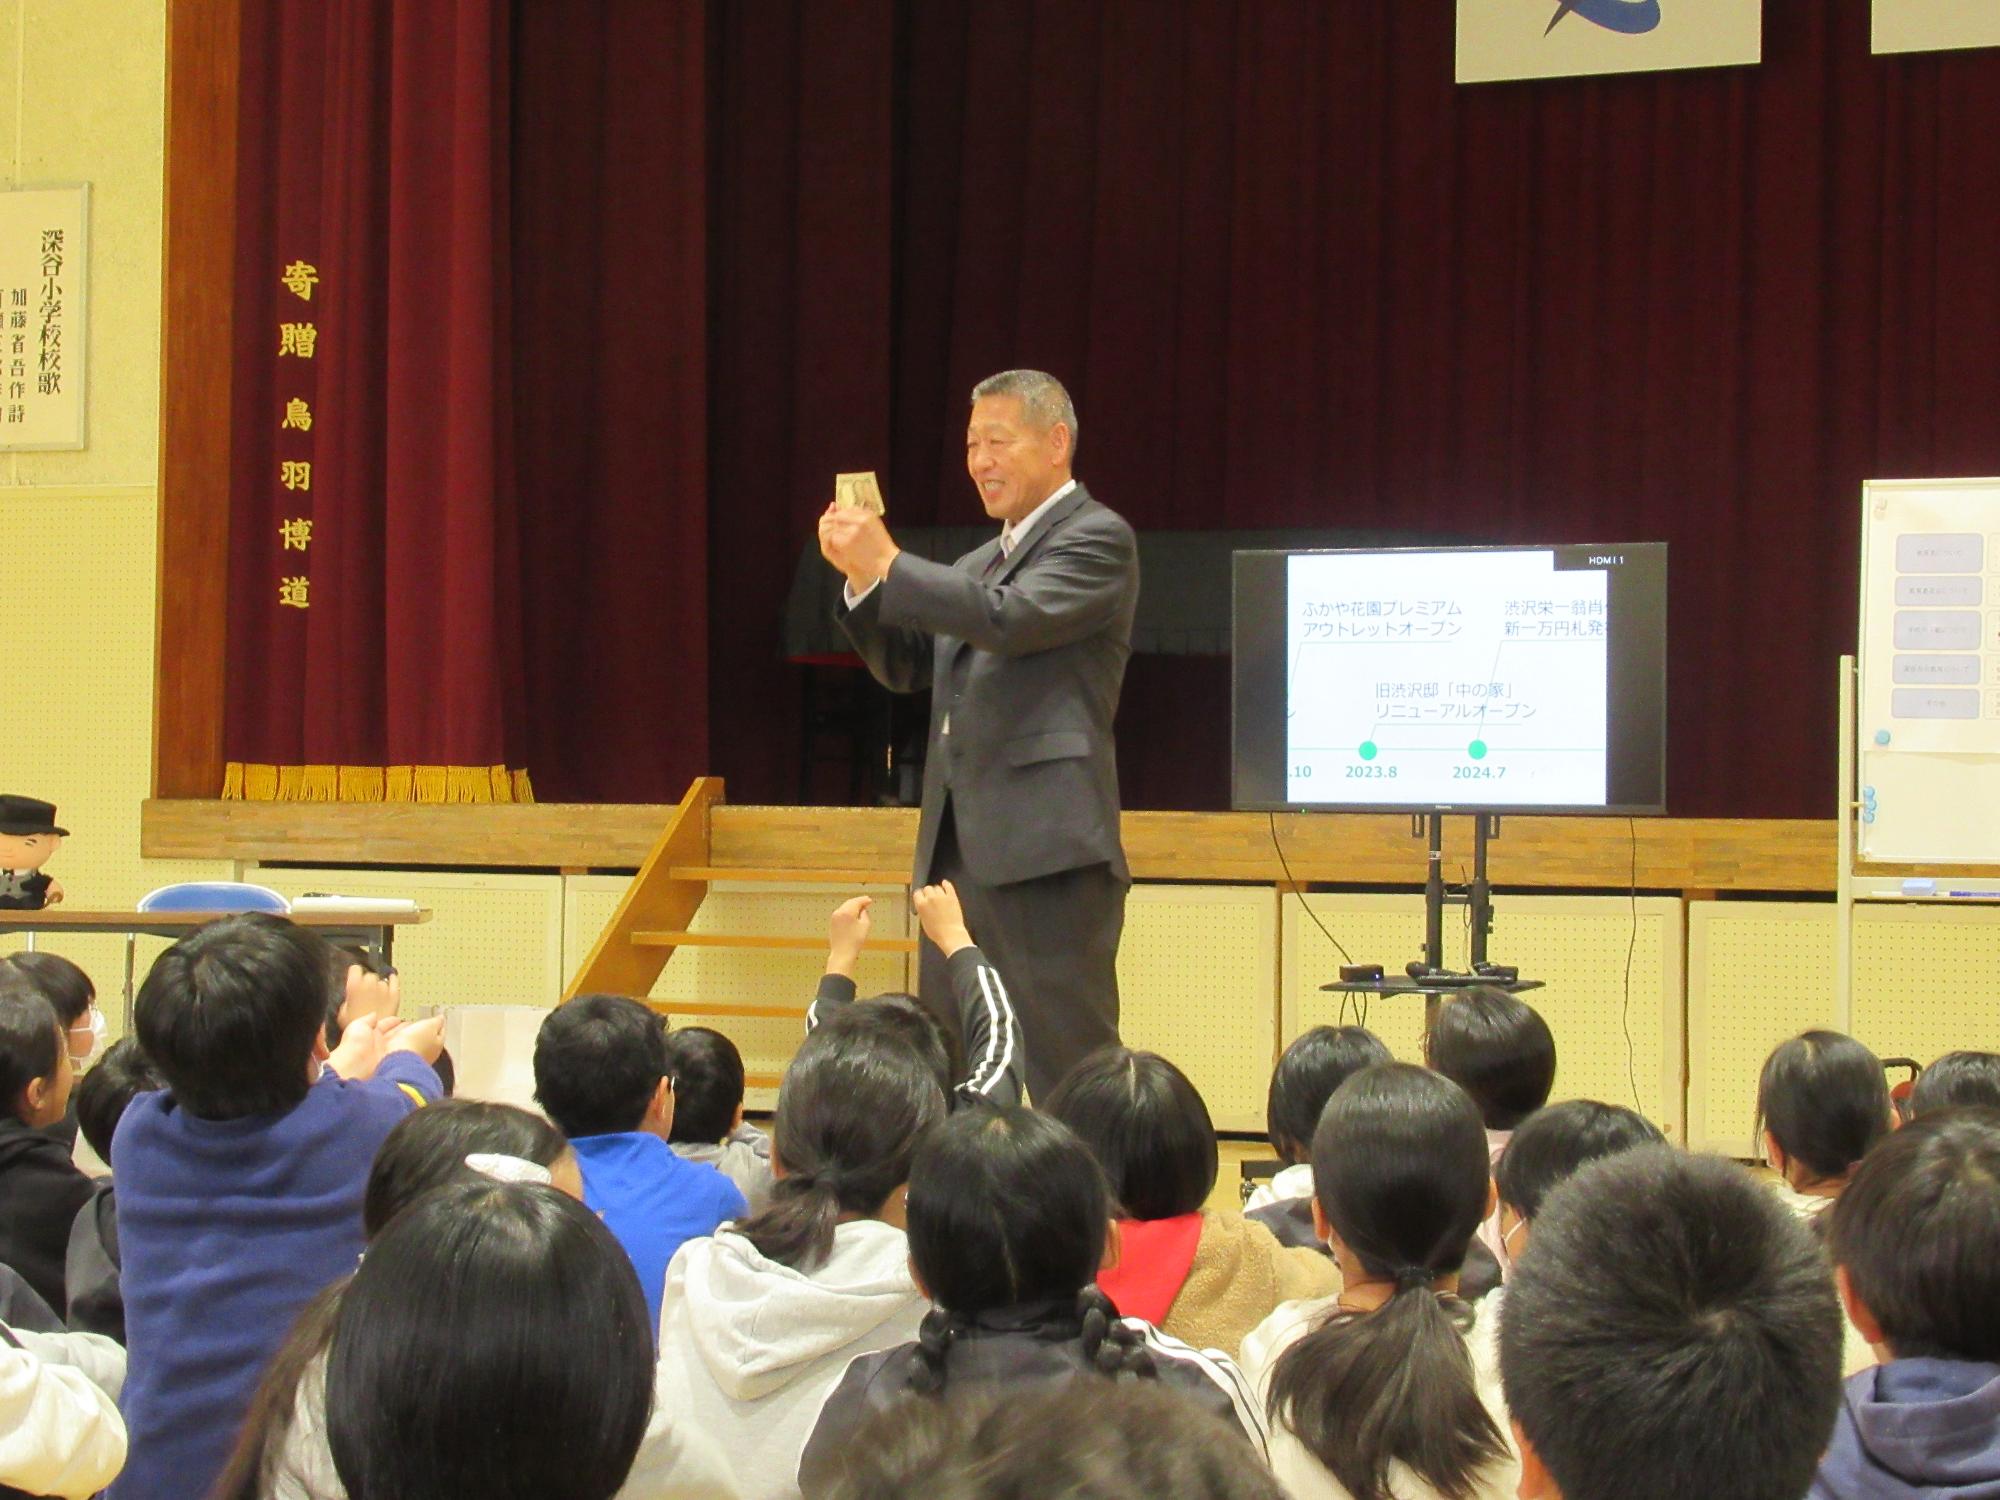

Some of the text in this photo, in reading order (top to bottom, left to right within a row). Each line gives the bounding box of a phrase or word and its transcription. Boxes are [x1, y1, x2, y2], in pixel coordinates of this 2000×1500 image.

[38, 229, 64, 395] 深谷小学校校歌
[8, 288, 27, 423] 加藤省吾作詩
[1302, 599, 1463, 617] ふかや花園プレミアム
[1504, 599, 1606, 616] 渋沢栄一翁肖
[1303, 620, 1462, 637] アウトレットオープン
[1504, 619, 1606, 636] 新一万円札発
[1375, 682, 1512, 699] 旧渋沢邸「中の家」
[1376, 702, 1537, 719] リニューアルオープン
[1345, 765, 1398, 779] 2023.8
[1452, 765, 1507, 779] 2024.7
